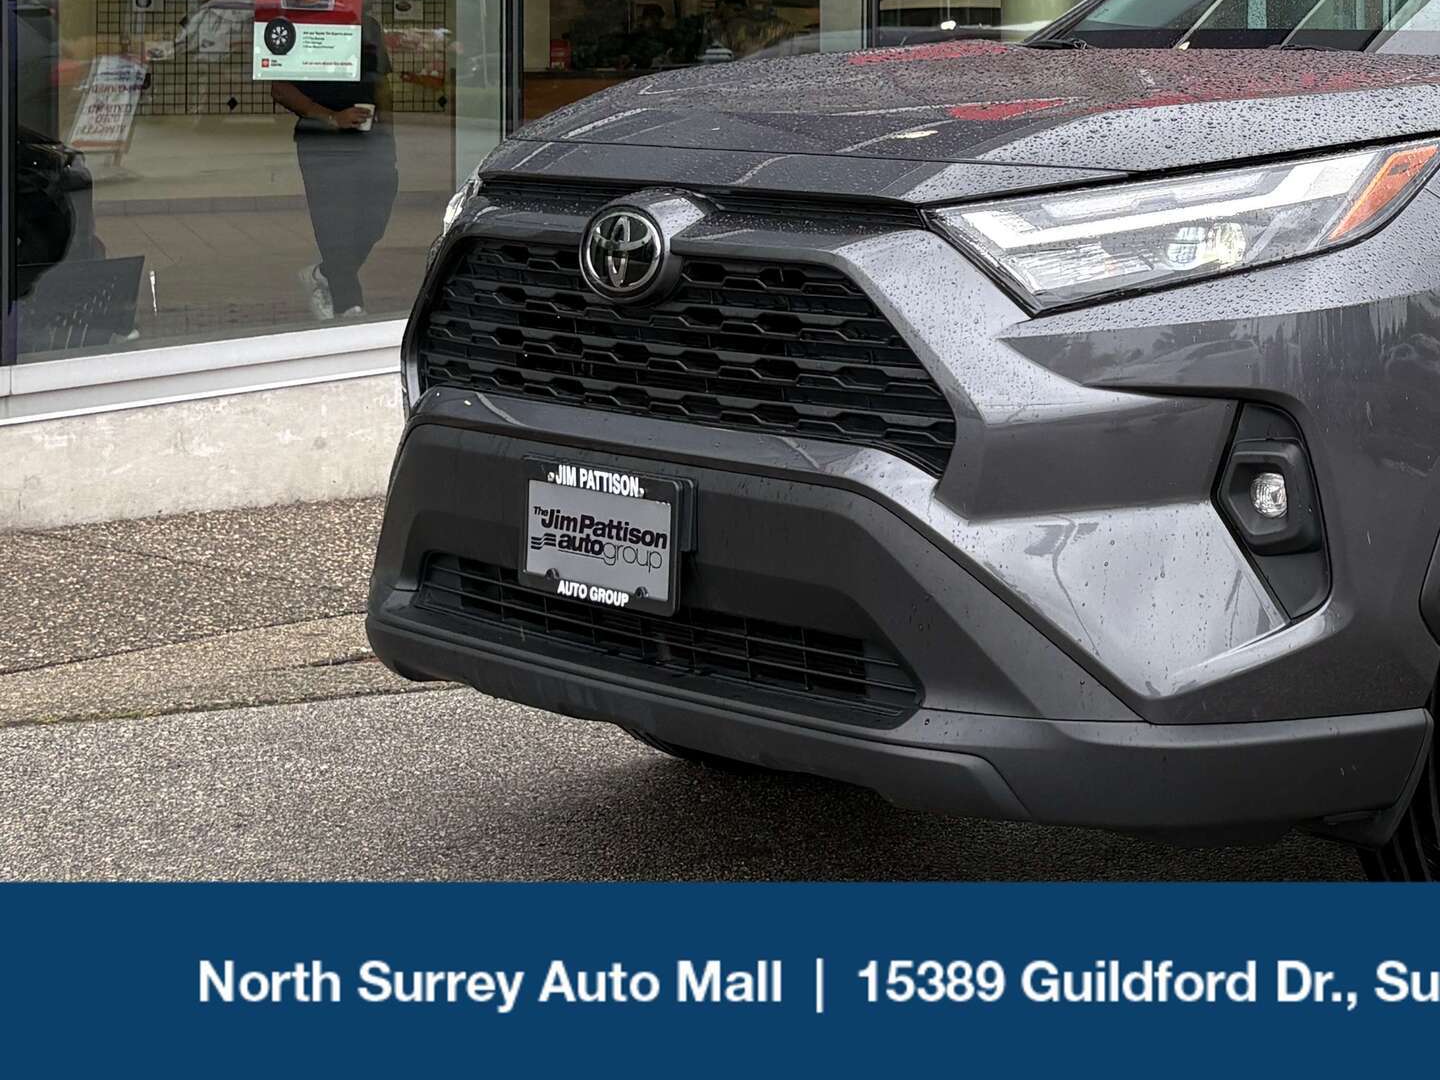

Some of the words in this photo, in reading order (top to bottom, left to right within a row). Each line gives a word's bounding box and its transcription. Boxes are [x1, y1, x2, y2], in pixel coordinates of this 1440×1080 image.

[555, 464, 577, 487] JIM
[579, 468, 640, 497] PATTISON
[533, 506, 548, 517] The
[557, 580, 588, 600] AUTO
[589, 585, 630, 608] GROUP
